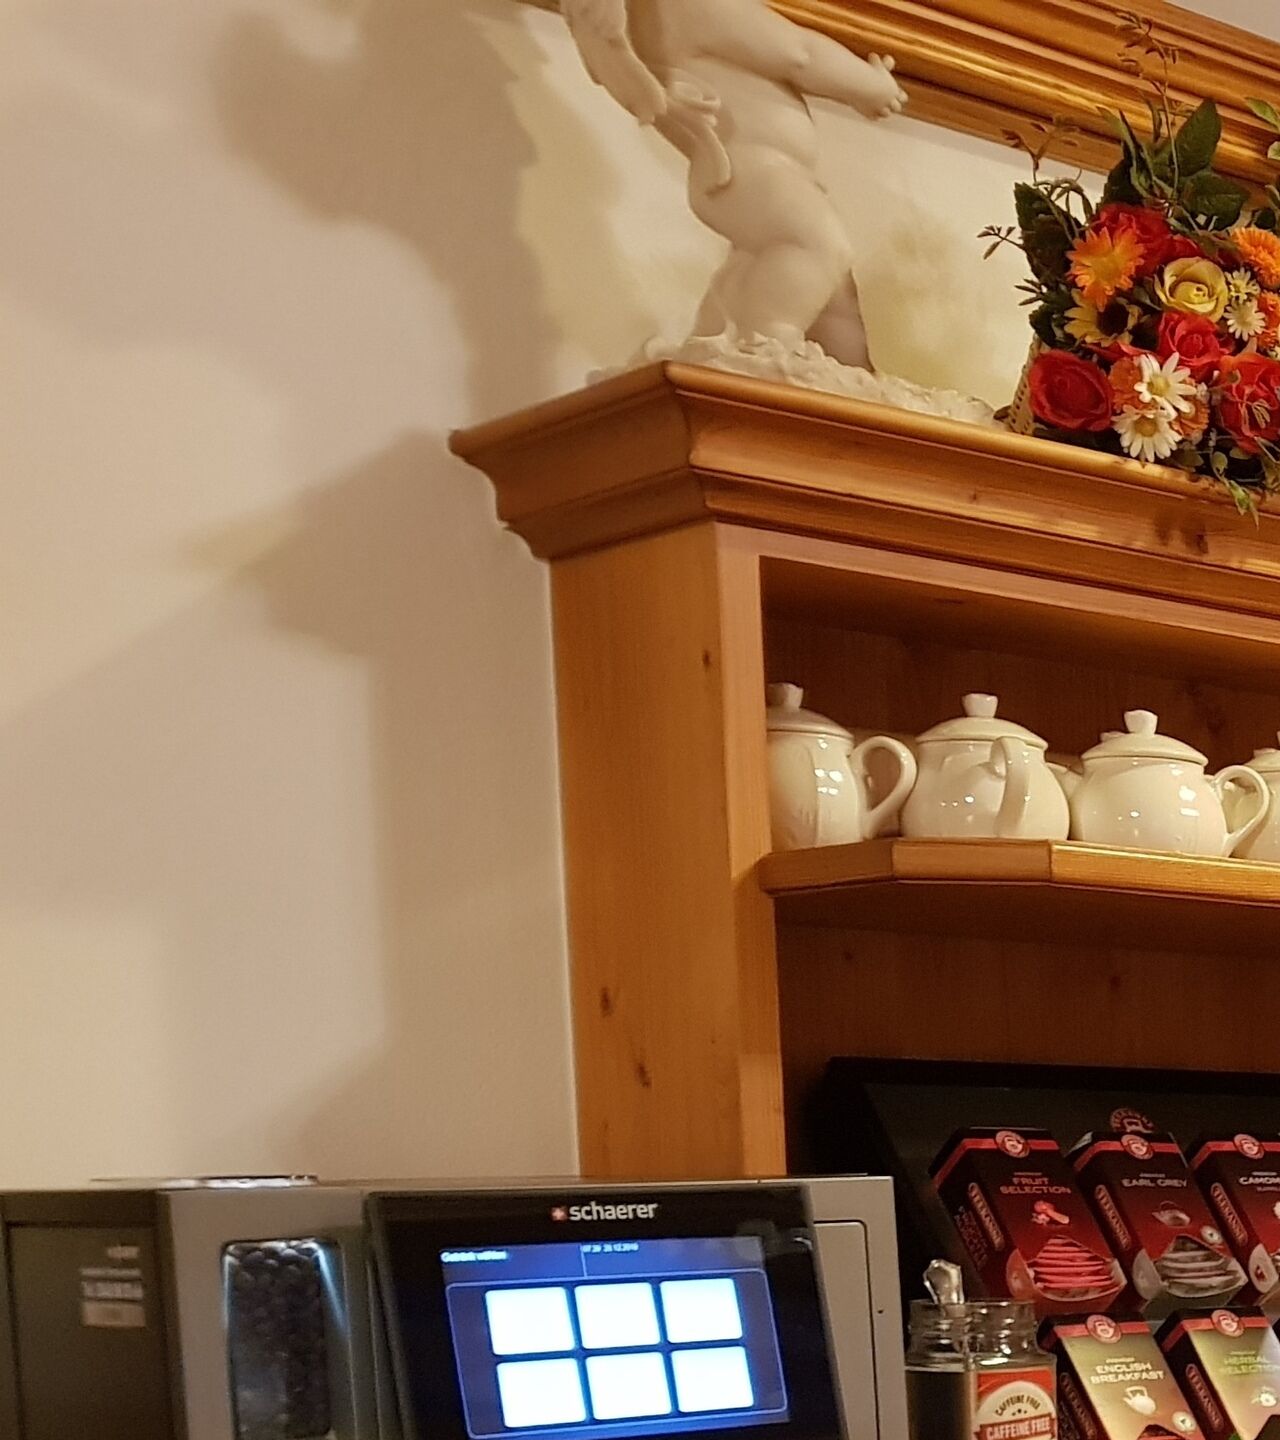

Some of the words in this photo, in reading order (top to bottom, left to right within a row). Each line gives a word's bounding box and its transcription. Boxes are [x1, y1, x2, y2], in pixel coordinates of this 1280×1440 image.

[1012, 1177, 1049, 1185] FRUIT
[1122, 1178, 1156, 1187] EARL
[1157, 1178, 1187, 1187] GREY
[1000, 1186, 1071, 1194] SELECTION
[568, 1200, 659, 1221] schaerer
[1095, 1362, 1152, 1374] ENGLISH
[1090, 1370, 1165, 1384] BREAKFAST
[995, 1394, 1025, 1416] CAFFEINE
[986, 1420, 1030, 1440] CAFFEINE
[1031, 1416, 1051, 1434] FREE
